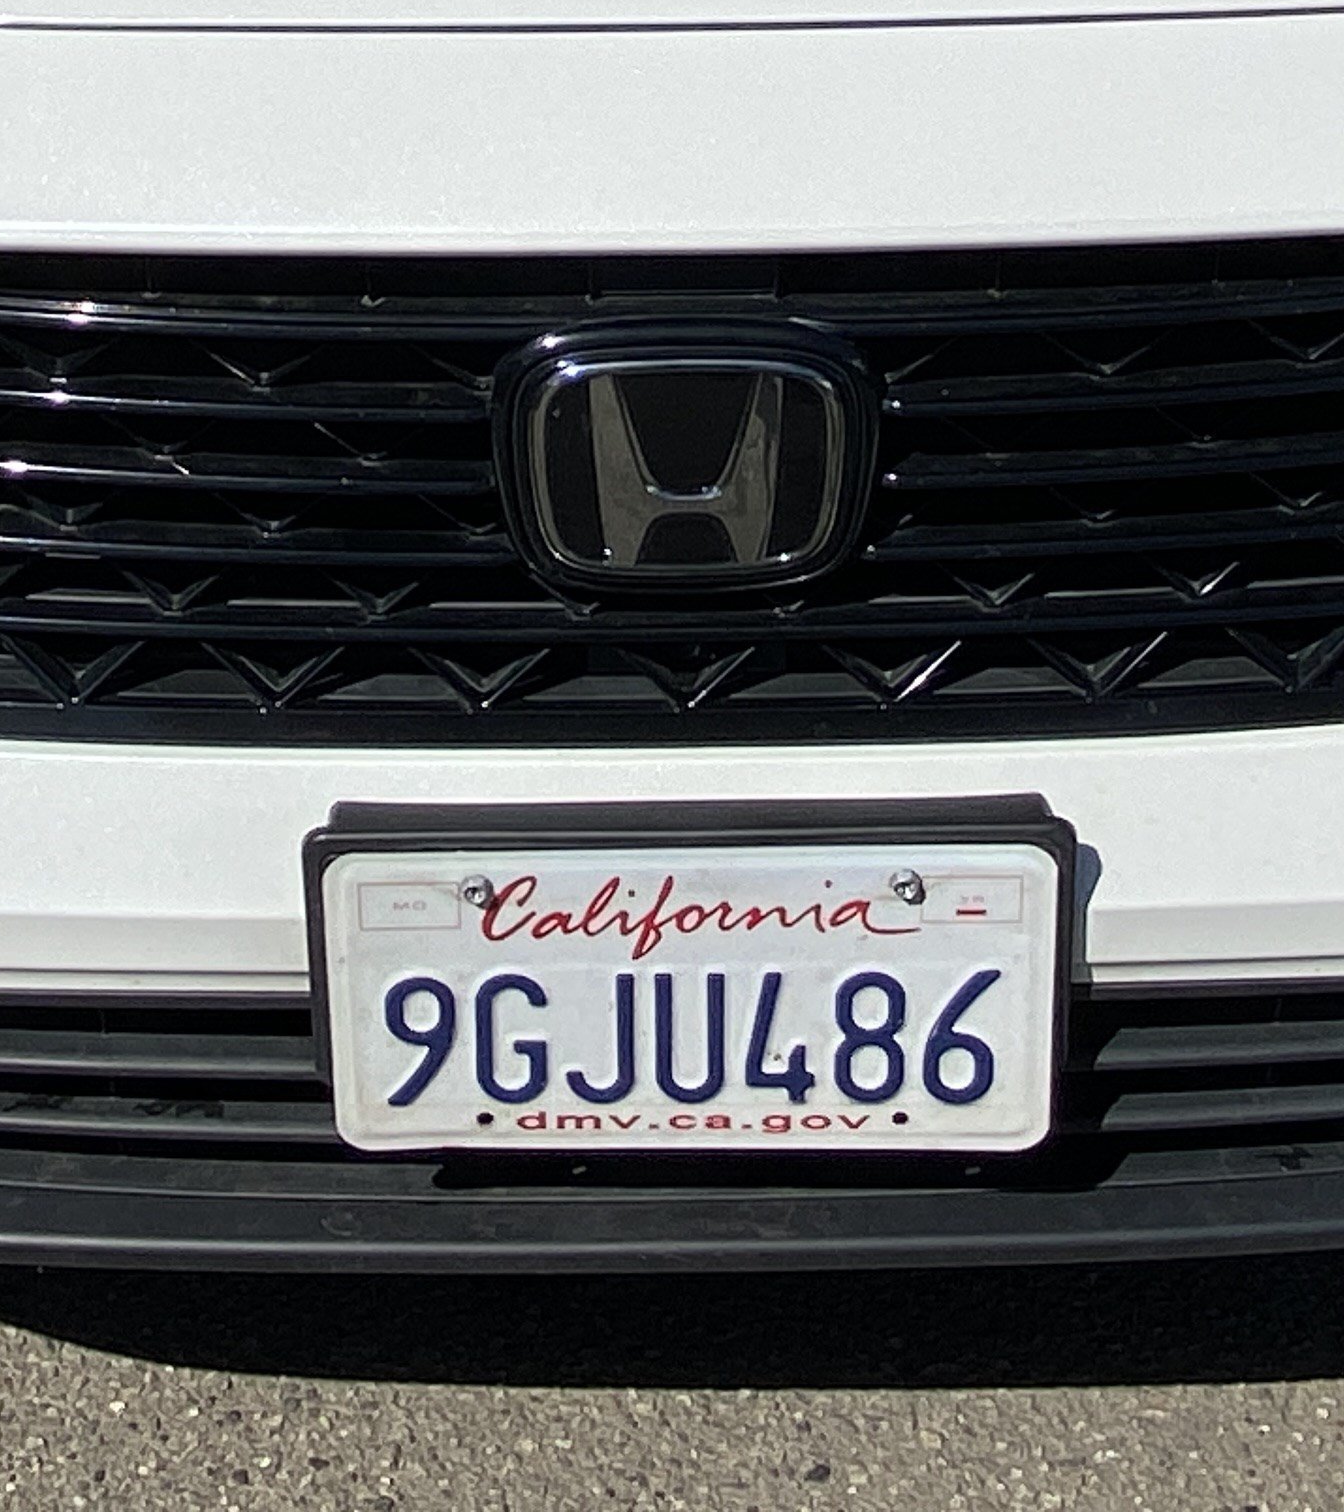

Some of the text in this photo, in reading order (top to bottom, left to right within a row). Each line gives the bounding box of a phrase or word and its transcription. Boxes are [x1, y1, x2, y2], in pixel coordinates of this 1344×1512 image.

[481, 875, 922, 960] California
[384, 969, 1002, 1107] 9GJU486
[516, 1109, 873, 1133] dmv.ca.gov
